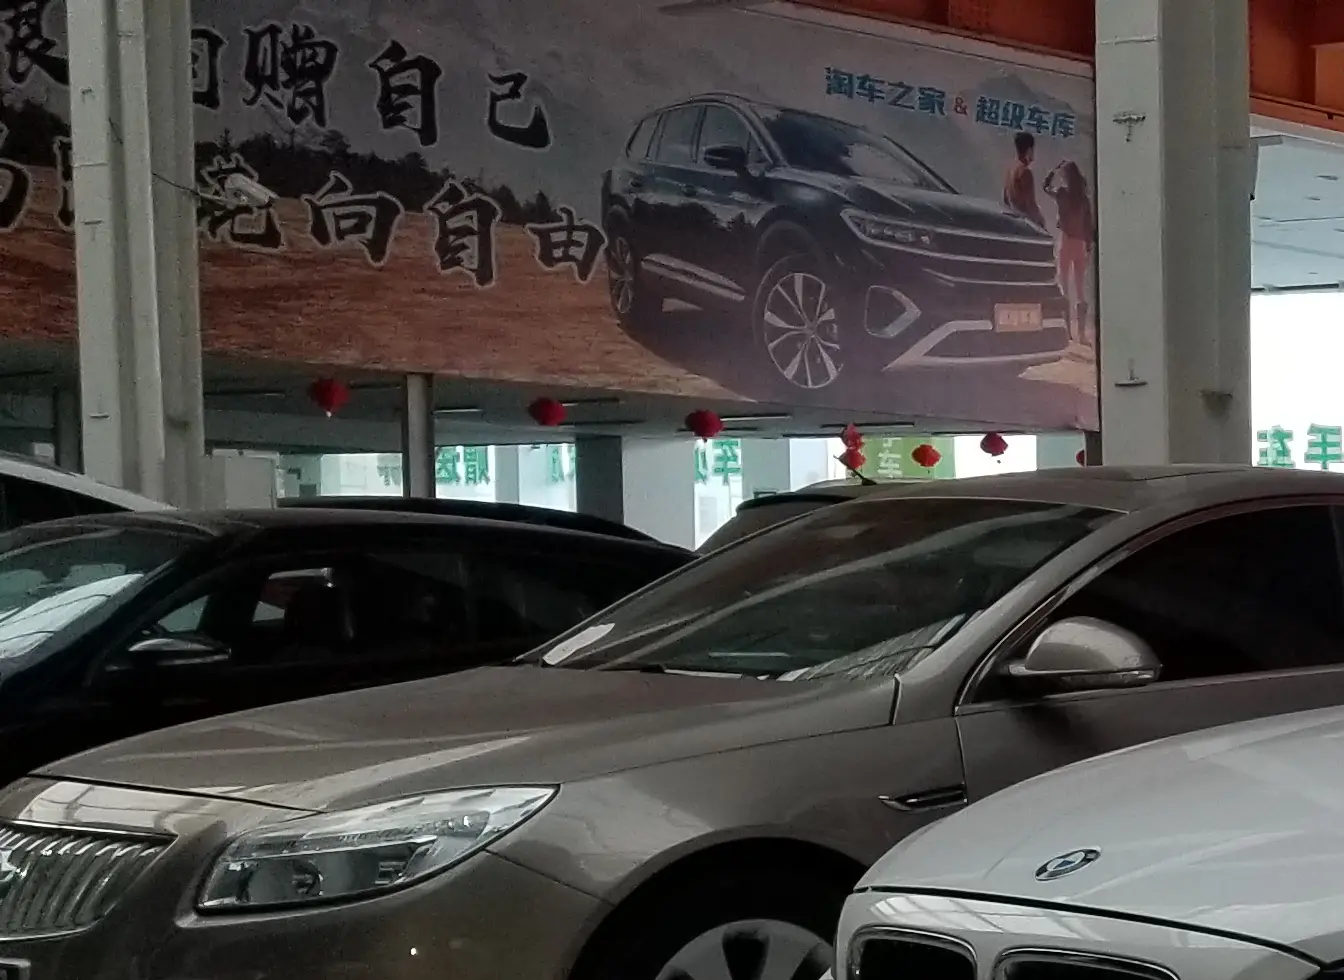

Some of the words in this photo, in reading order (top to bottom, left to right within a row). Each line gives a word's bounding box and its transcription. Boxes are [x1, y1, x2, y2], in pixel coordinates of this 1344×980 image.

[824, 66, 946, 116] 淘车之家
[953, 96, 968, 117] &
[976, 96, 1076, 138] 超级车库
